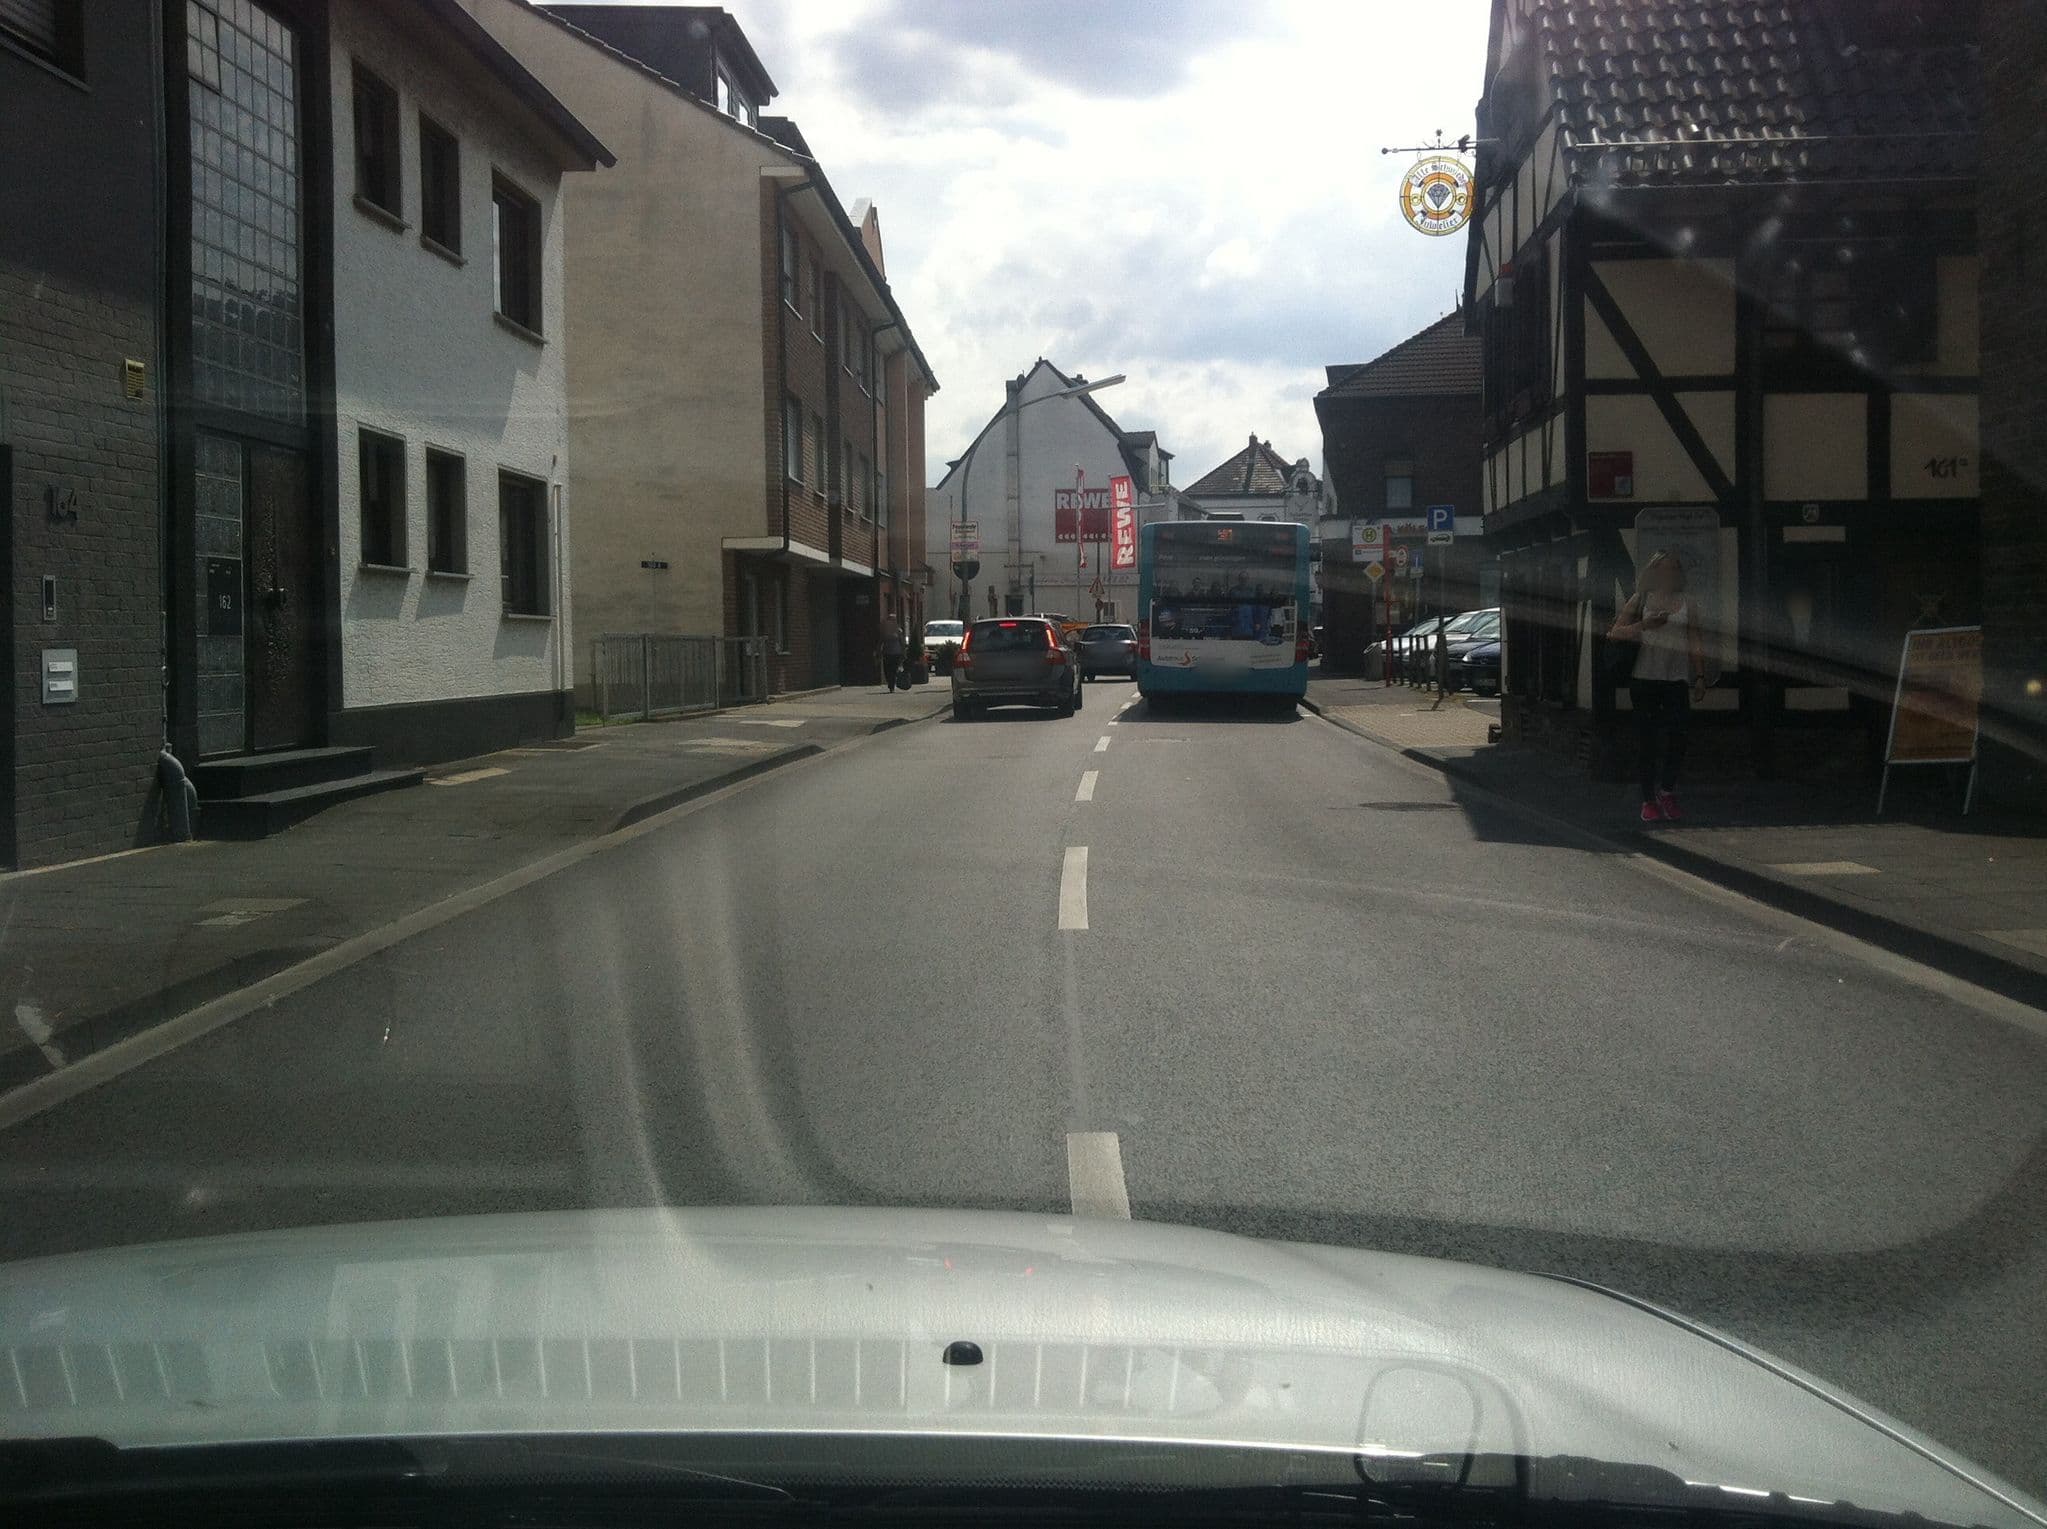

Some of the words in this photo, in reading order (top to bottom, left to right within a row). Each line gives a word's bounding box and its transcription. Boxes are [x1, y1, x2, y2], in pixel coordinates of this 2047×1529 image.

[1419, 217, 1459, 230] Juwelier
[1056, 492, 1110, 509] REWE
[1115, 481, 1134, 566] REWE
[1433, 508, 1447, 530] P
[219, 594, 232, 610] 162
